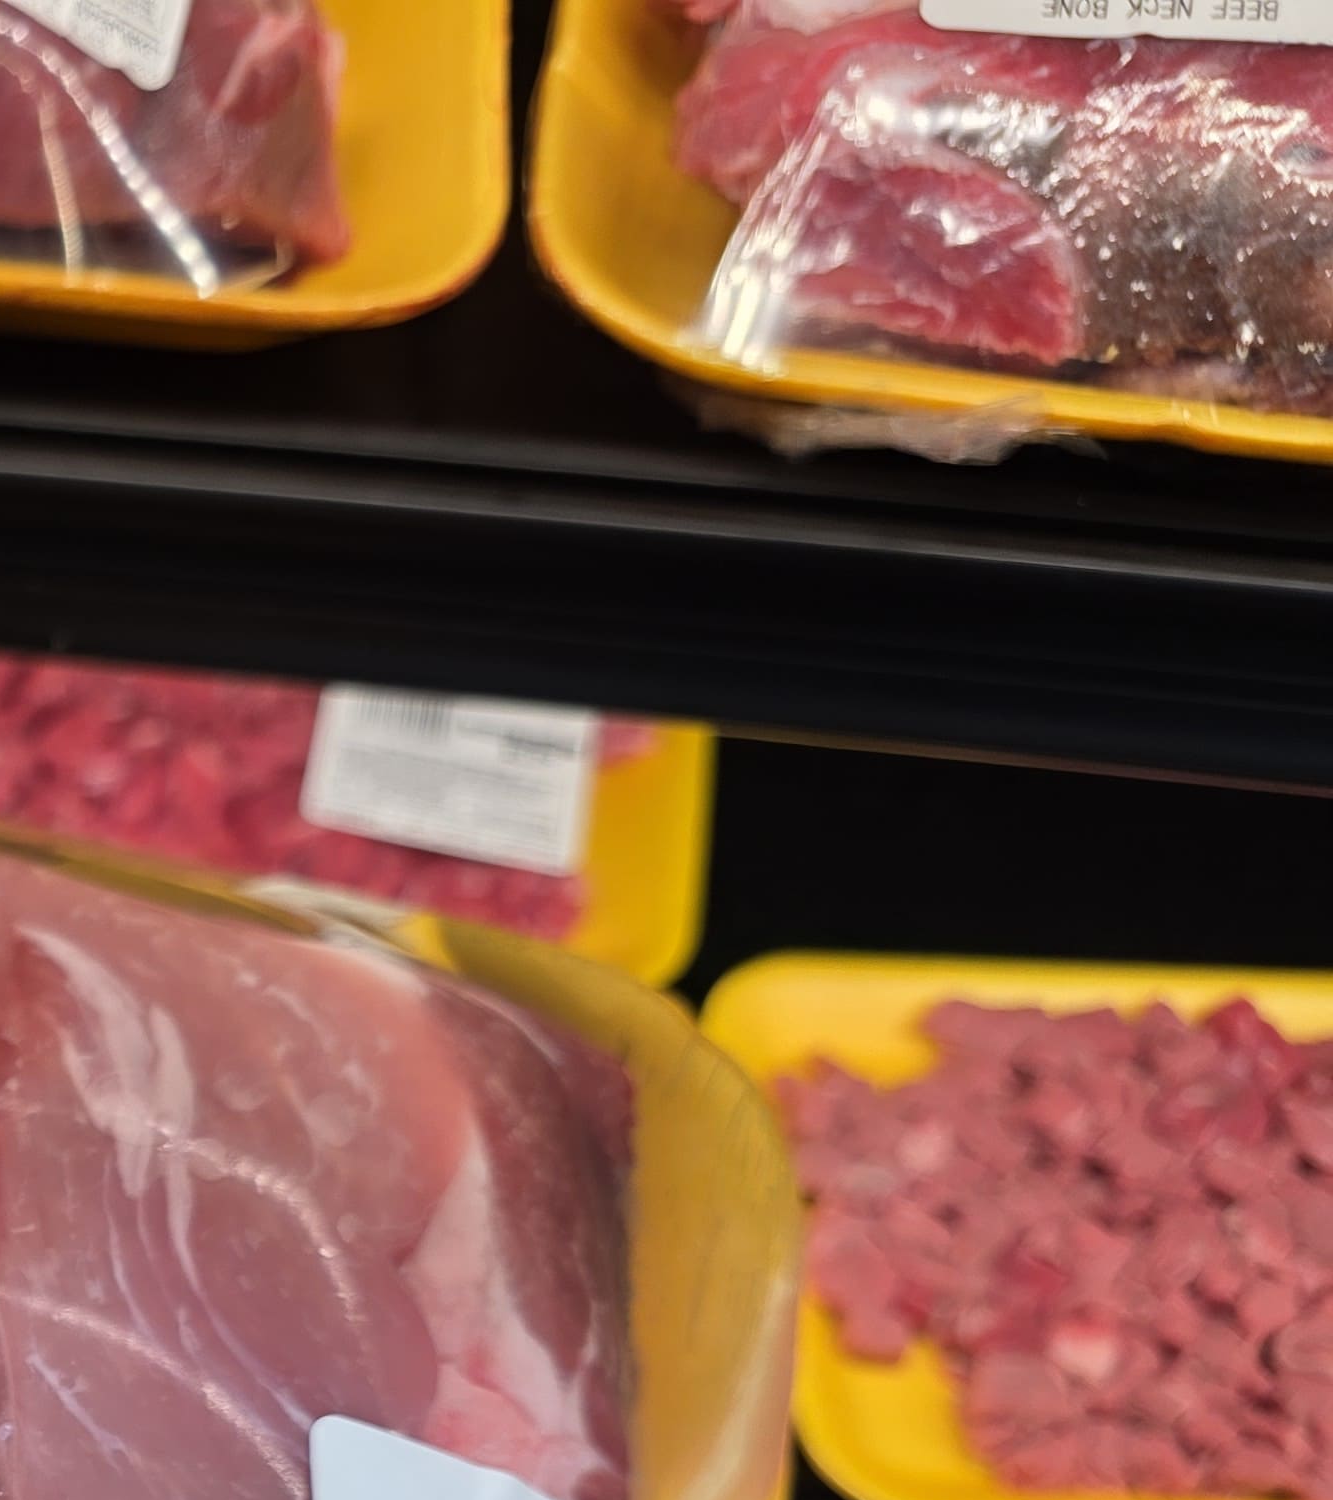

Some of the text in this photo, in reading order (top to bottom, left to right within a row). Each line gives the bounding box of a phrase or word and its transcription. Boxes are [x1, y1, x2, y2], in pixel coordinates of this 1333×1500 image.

[1041, 0, 1279, 22] BEEF NECK BONE
